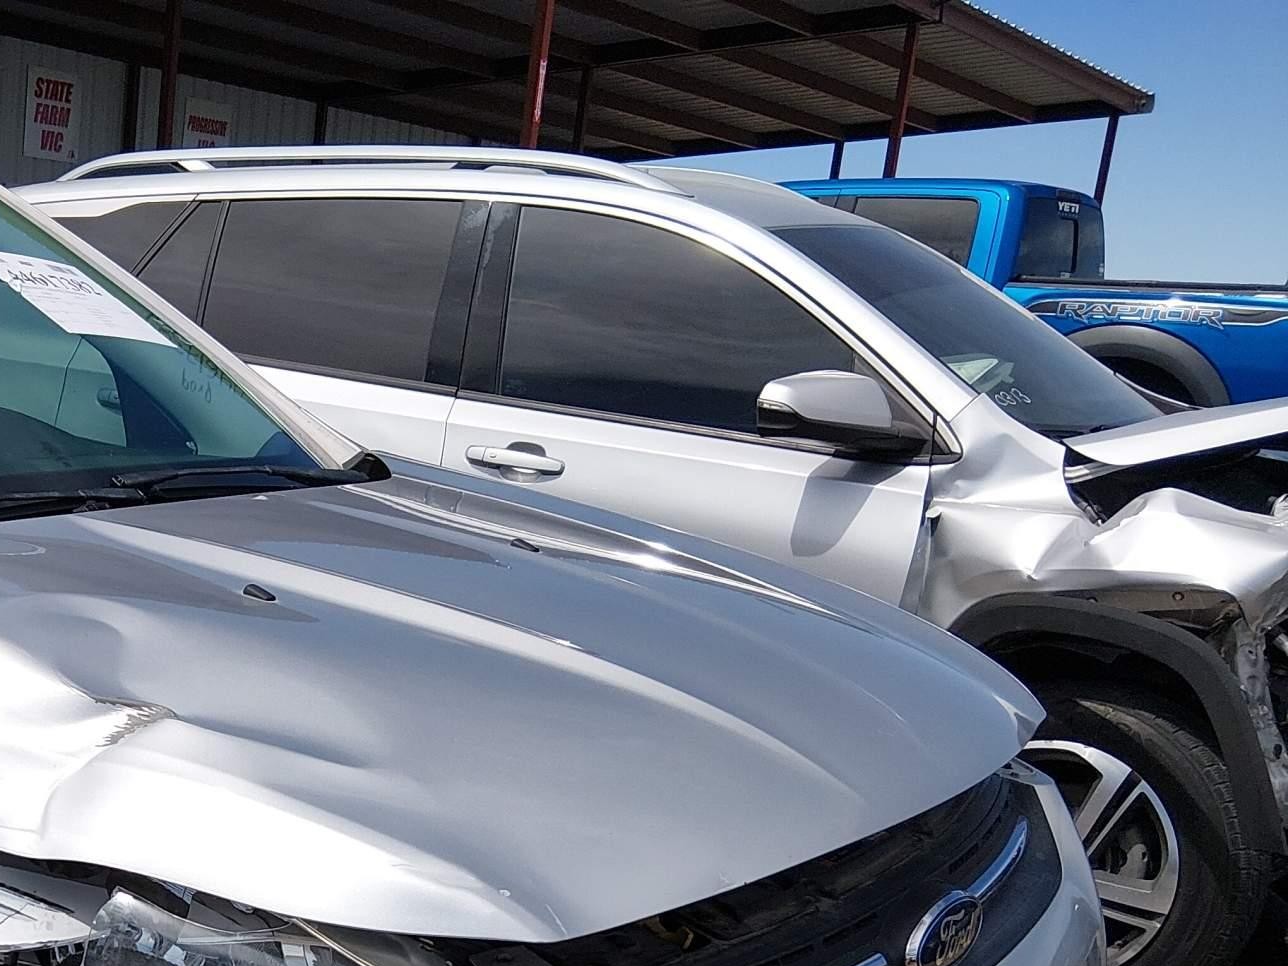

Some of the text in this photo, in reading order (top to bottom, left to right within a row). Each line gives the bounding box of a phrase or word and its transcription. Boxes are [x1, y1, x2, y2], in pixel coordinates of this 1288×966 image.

[34, 76, 74, 104] STATE
[33, 103, 71, 128] FARM
[187, 114, 228, 137] PROGRESSIVE
[40, 129, 64, 153] VIC
[1058, 201, 1080, 214] YETI
[1056, 301, 1225, 330] RAPTOR
[934, 908, 978, 966] Ford
